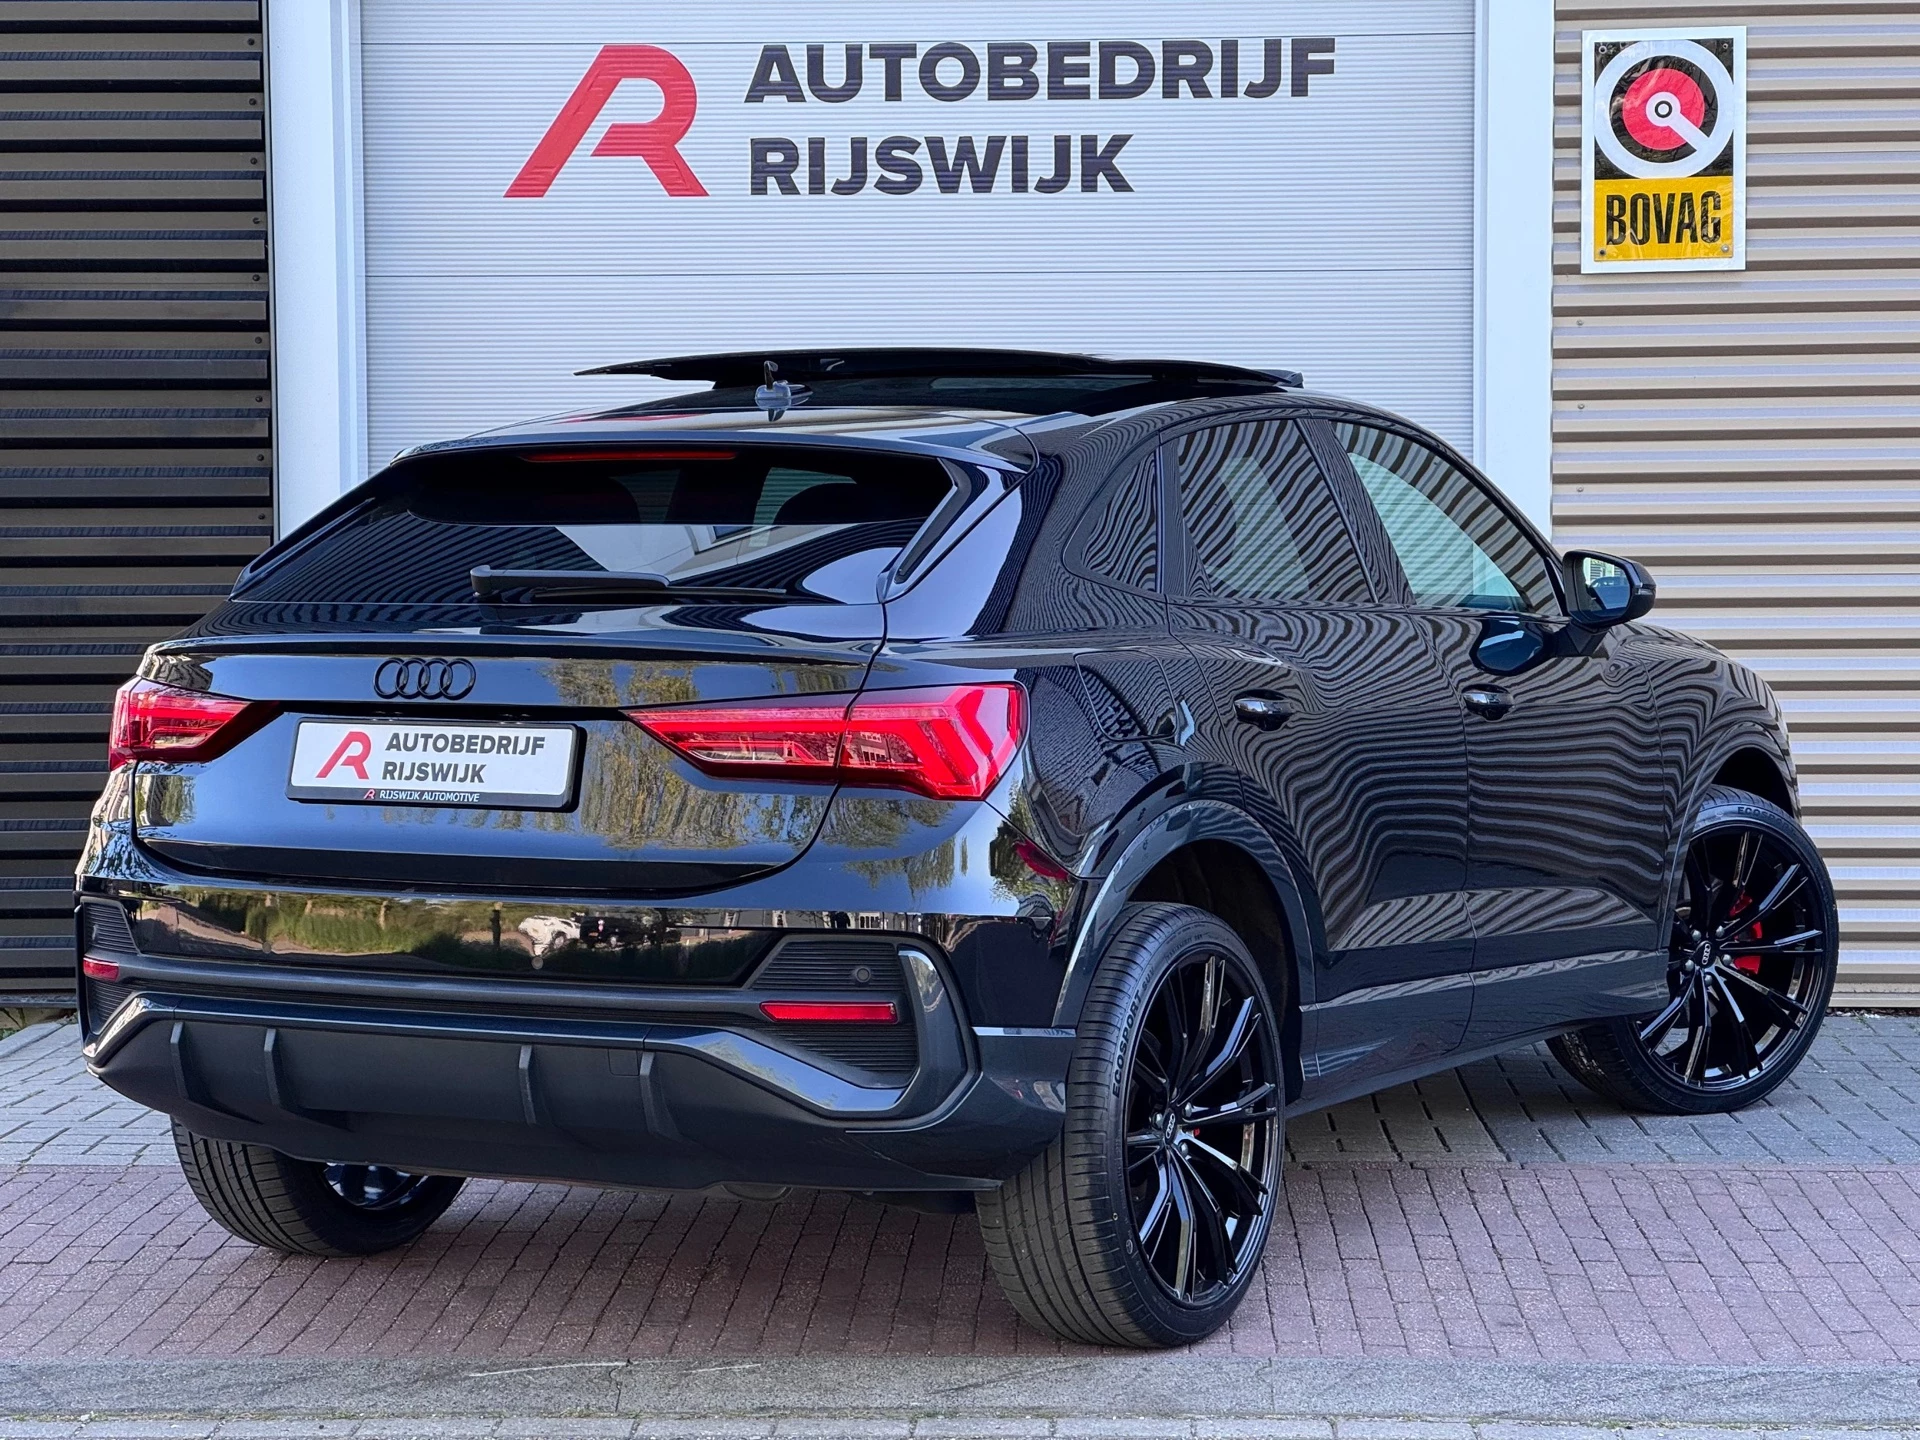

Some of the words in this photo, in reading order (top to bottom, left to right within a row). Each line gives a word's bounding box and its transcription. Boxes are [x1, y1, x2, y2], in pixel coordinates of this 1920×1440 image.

[744, 37, 1336, 104] AUTOBEDRIJF
[750, 134, 1135, 195] RIJSWIJK
[1606, 191, 1721, 245] BOVAG
[385, 732, 545, 756] AUTOBEDRIJF
[379, 789, 420, 800] RIJSWIJK
[422, 791, 480, 803] AUTOMOTIVE
[381, 761, 486, 783] RIJSWIJK
[1112, 989, 1142, 1098] ECOSPORT
